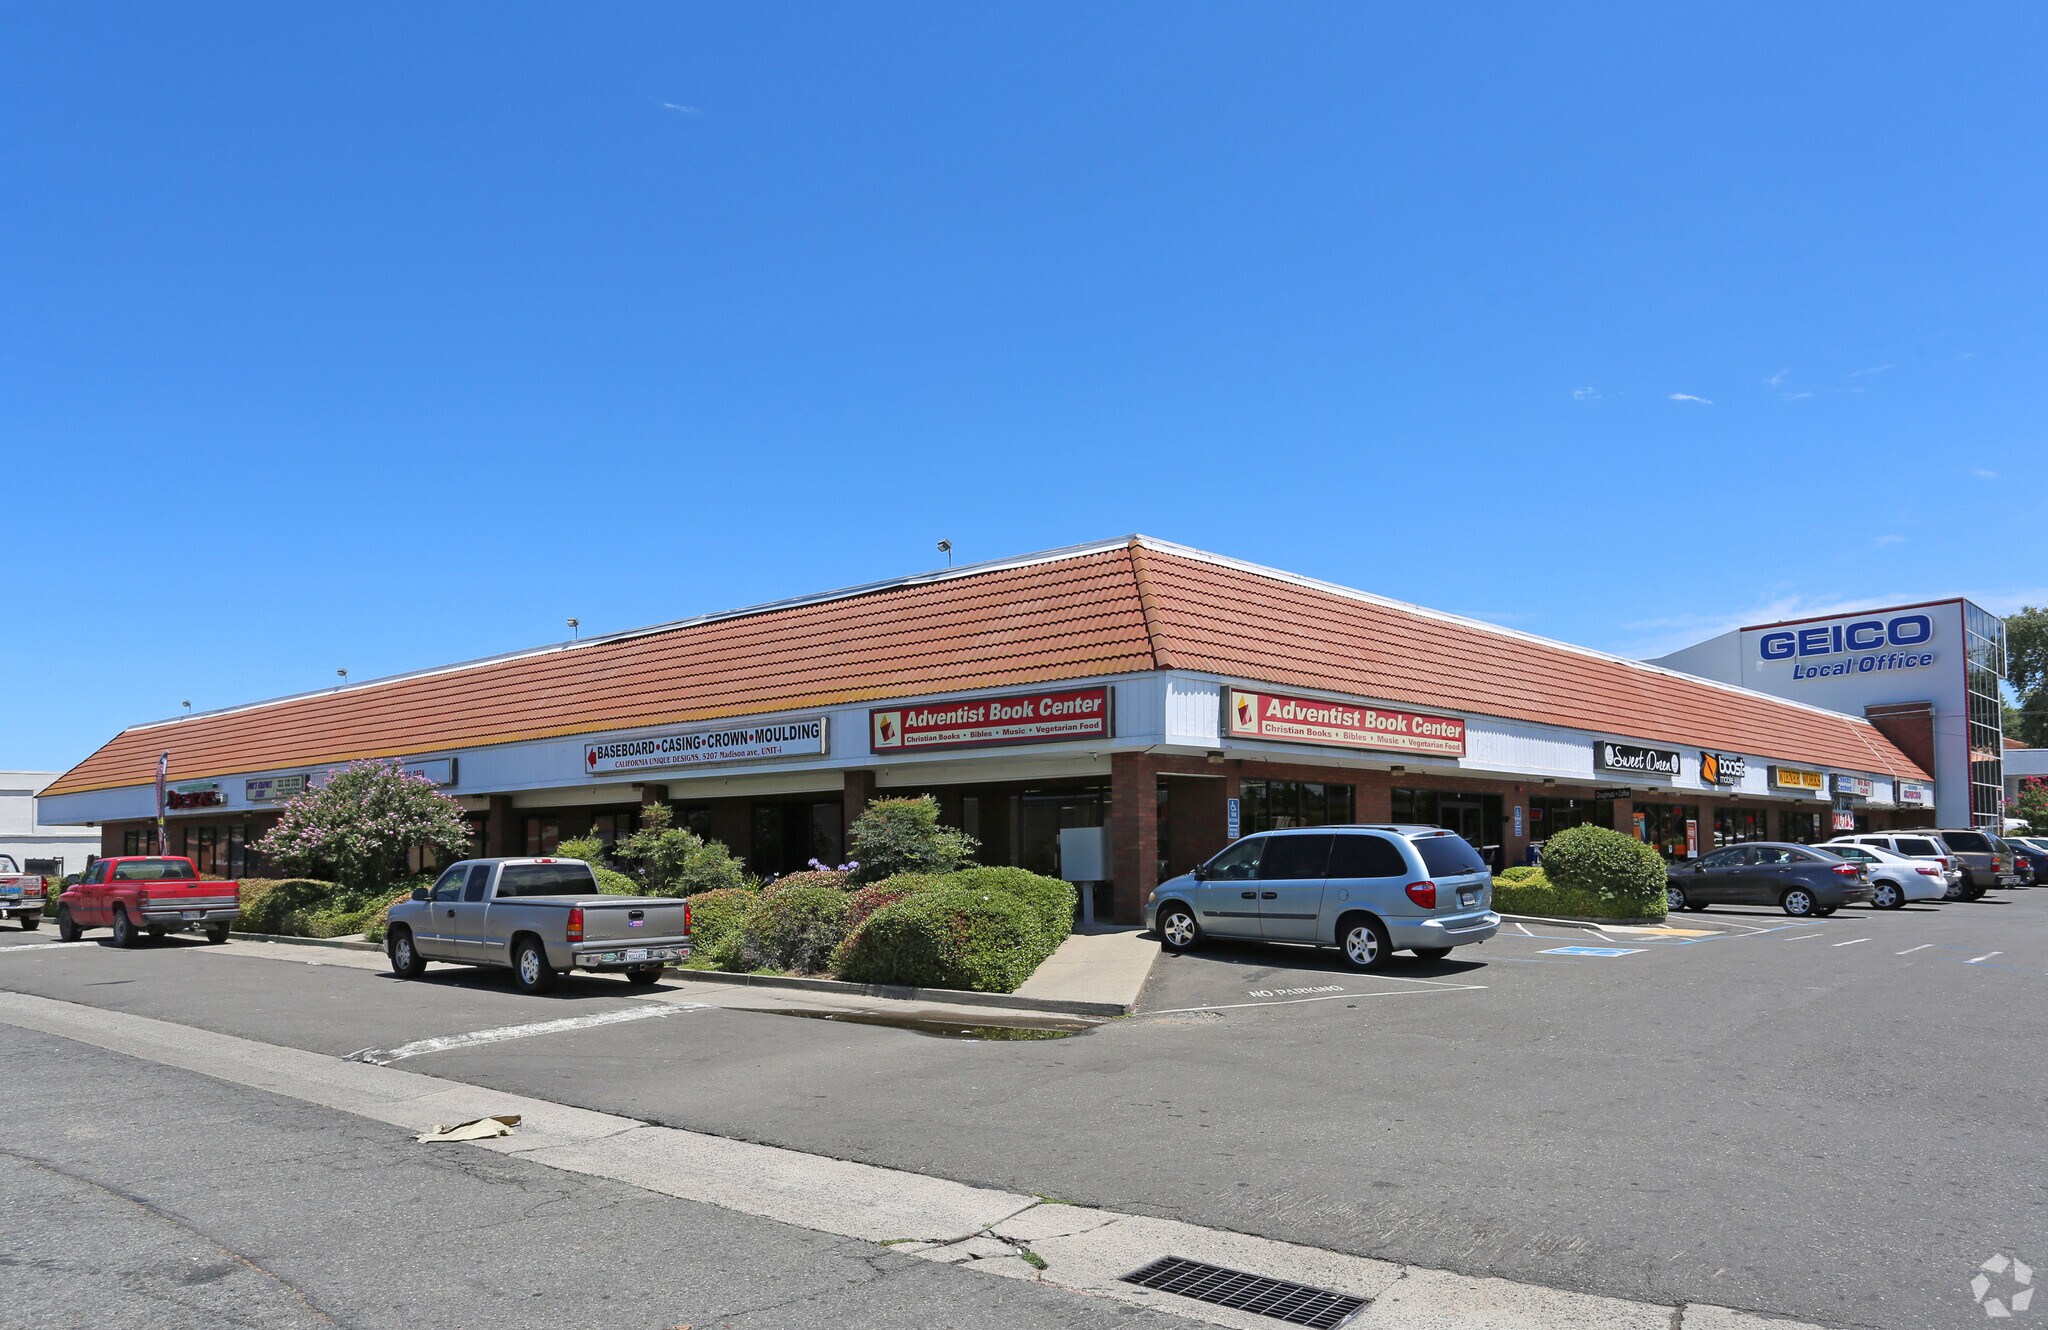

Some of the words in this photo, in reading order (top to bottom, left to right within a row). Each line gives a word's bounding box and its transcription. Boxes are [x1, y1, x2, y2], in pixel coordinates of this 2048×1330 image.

[1760, 614, 1932, 661] GEICO
[1793, 658, 1853, 680] Local
[1858, 652, 1934, 674] Office
[905, 705, 985, 728] Adventist
[989, 700, 1034, 720] Book
[1039, 697, 1102, 716] Center
[1265, 698, 1361, 727] Adventist
[1365, 711, 1407, 732] Book
[1411, 717, 1462, 738] Center
[597, 740, 655, 760] BASEBOARD
[661, 735, 701, 753] CASING
[707, 730, 748, 749] CROWN
[755, 723, 819, 744] MOULDING
[906, 734, 937, 743] Christian
[938, 732, 960, 741] Books
[970, 730, 992, 738] Bibles
[1002, 727, 1026, 736] Music
[1036, 723, 1078, 735] Vegetarian
[1079, 721, 1099, 730] Food
[1265, 724, 1305, 735] Christian
[1307, 727, 1332, 738] Books
[1343, 731, 1367, 741] Bibles
[1377, 735, 1399, 744] Music
[1408, 739, 1444, 750] Vegetarian
[1445, 743, 1460, 751] Food
[615, 758, 649, 768] CALIFORNIA
[649, 756, 672, 766] UNIQUE
[703, 752, 717, 760] 5207
[720, 750, 745, 759] Madison
[1613, 746, 1644, 769] Sweet
[1646, 750, 1672, 772] Dozen
[1718, 755, 1745, 777] boost
[1720, 776, 1734, 785] mobile
[1248, 989, 1274, 998] NO
[1274, 985, 1345, 996] PARKING
